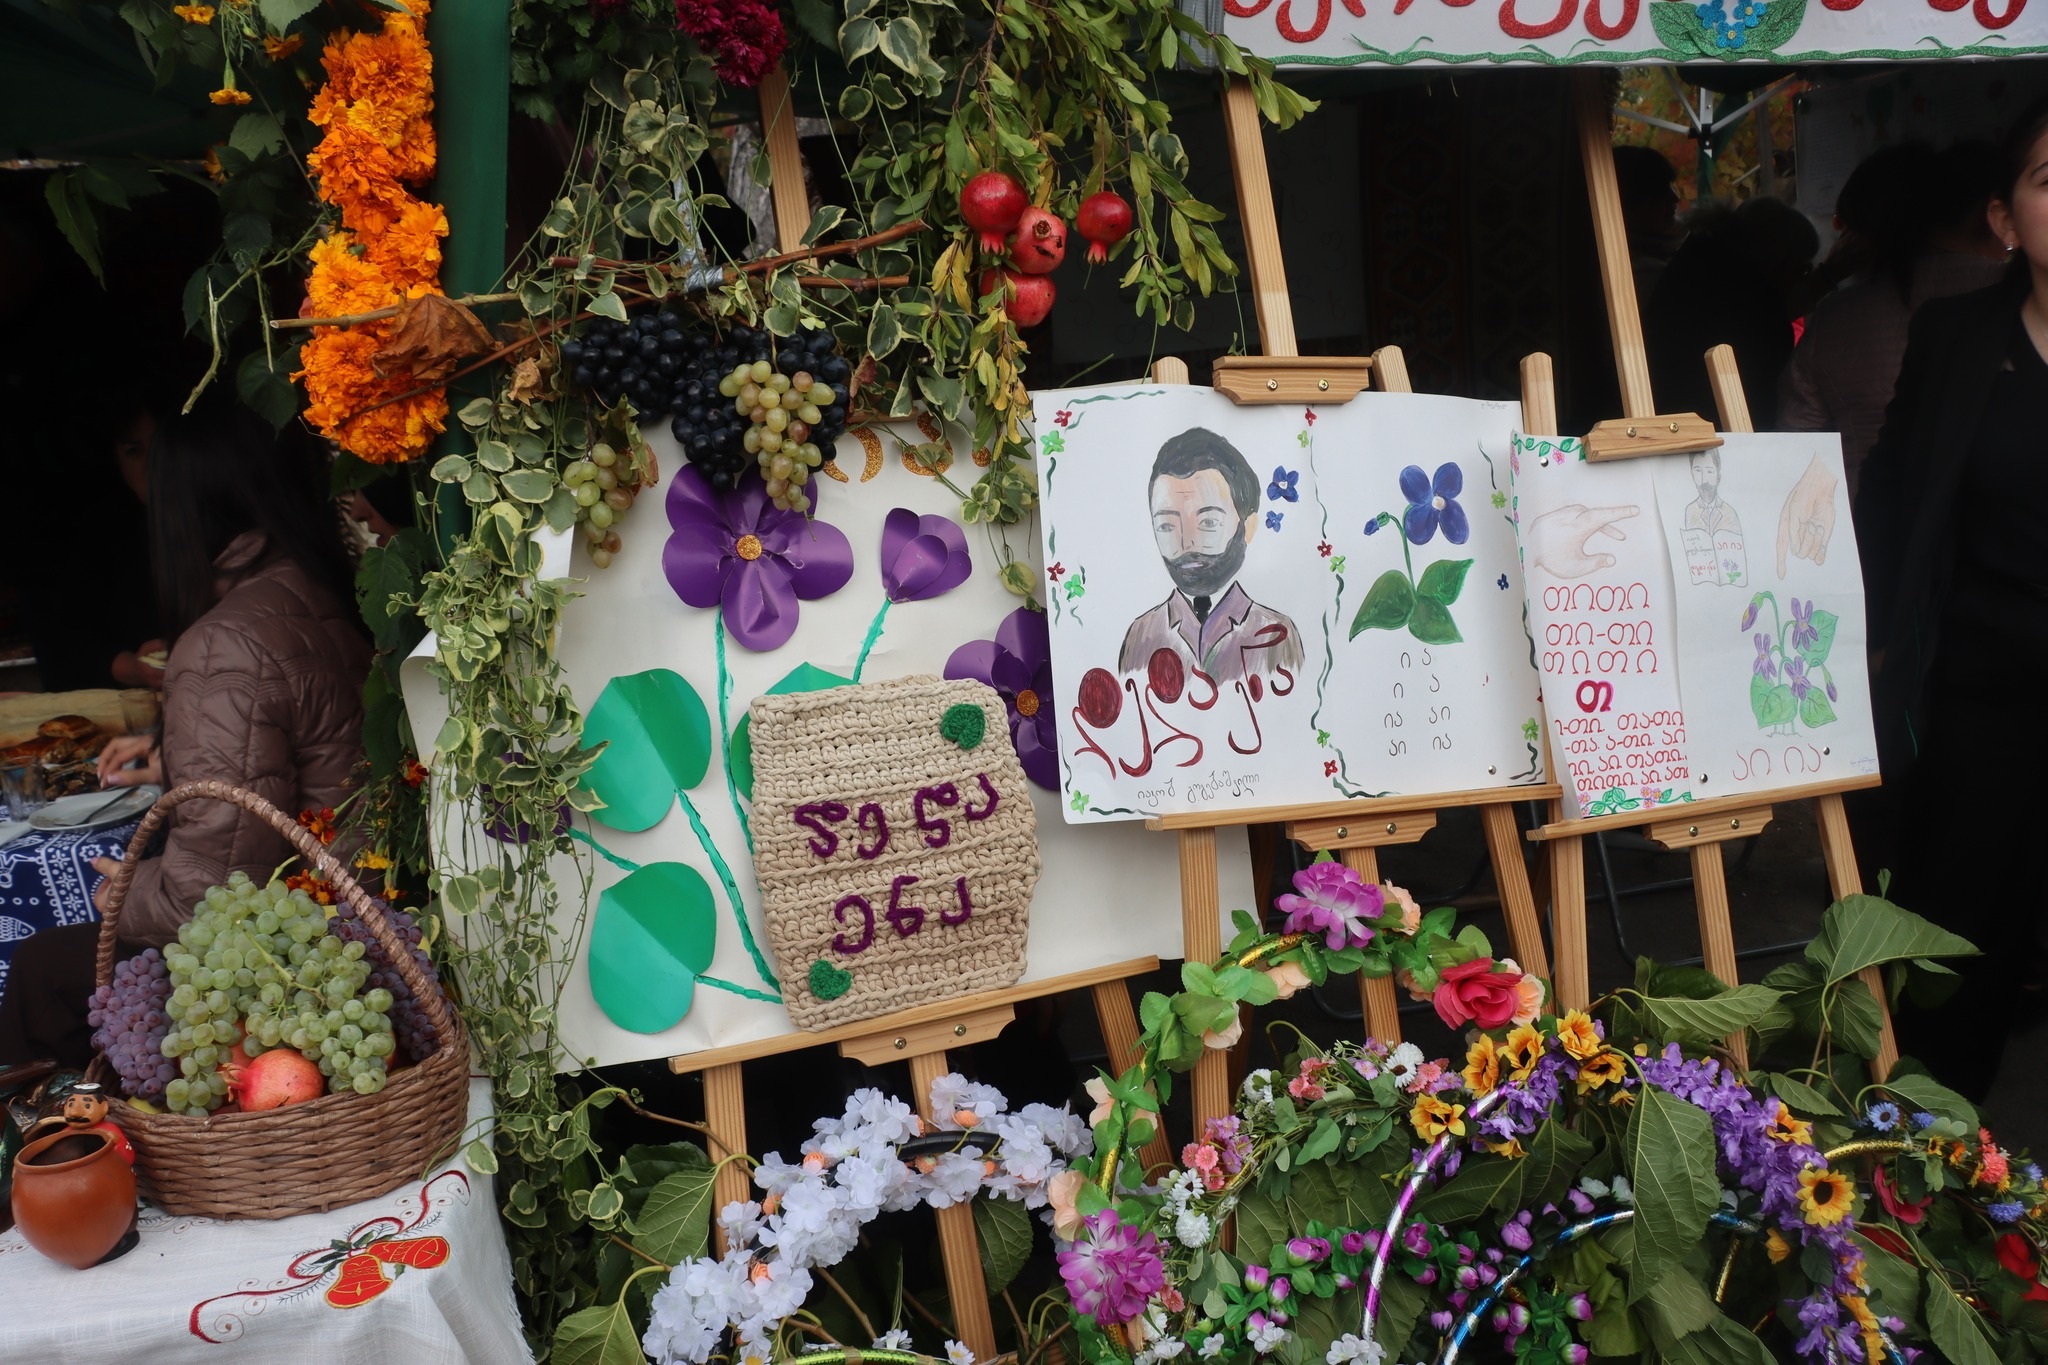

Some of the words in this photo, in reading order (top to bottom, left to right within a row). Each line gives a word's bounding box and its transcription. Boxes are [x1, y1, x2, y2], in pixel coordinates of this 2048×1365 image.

[1543, 583, 1650, 612] თითი
[1545, 620, 1654, 647] თი-თი
[1575, 680, 1615, 713] თ
[1072, 647, 1219, 780] დედა
[1383, 711, 1403, 729] ია
[1388, 739, 1407, 757] აი
[1432, 733, 1452, 750] ია
[794, 772, 1000, 861] დედა
[832, 876, 972, 955] ენა
